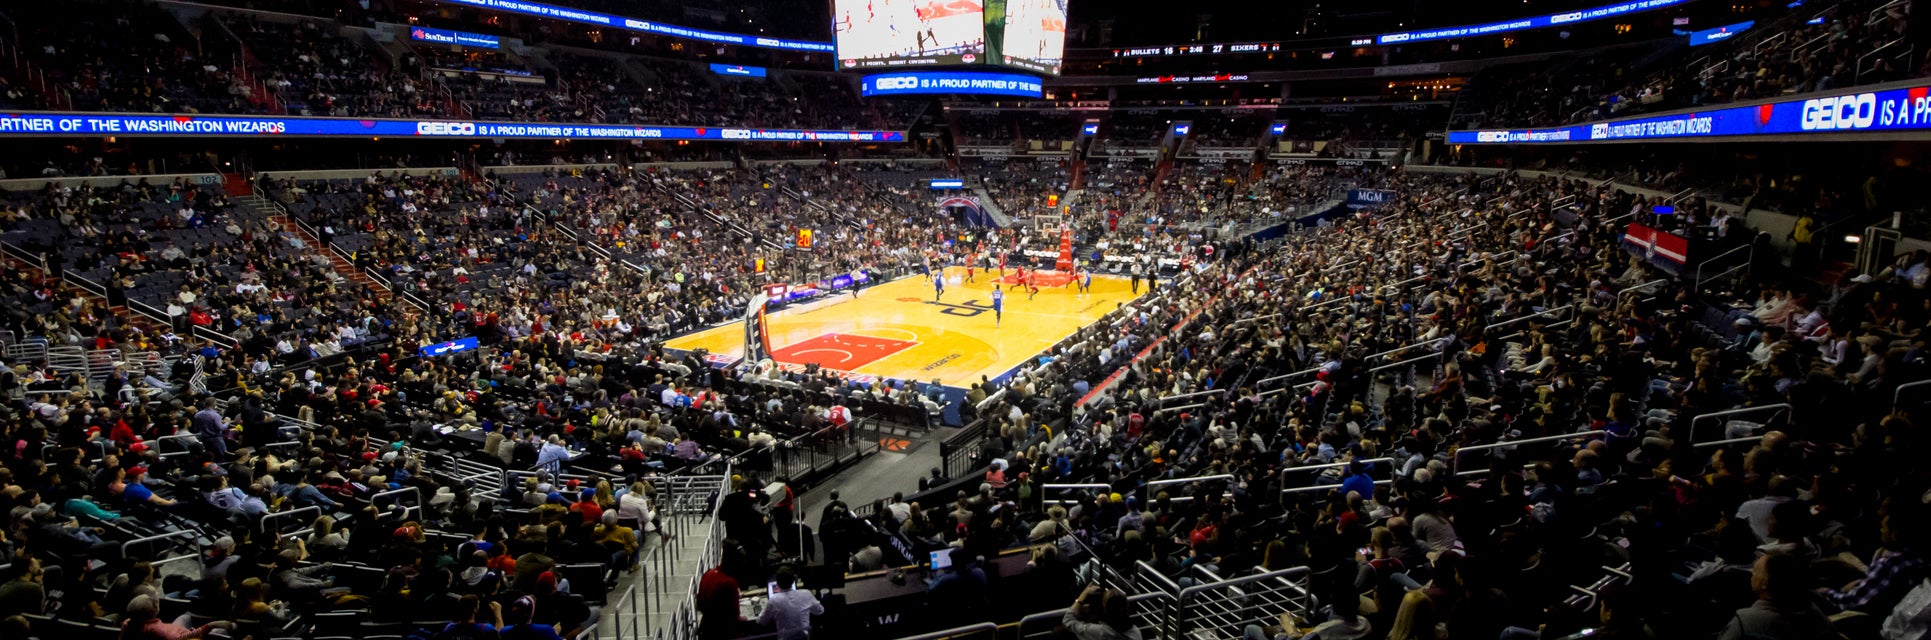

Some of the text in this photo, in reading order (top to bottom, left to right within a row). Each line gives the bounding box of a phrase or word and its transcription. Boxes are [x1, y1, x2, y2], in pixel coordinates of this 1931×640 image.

[1212, 45, 1223, 53] 27
[876, 76, 918, 90] GEICO
[921, 79, 930, 88] IS
[931, 79, 938, 88] A
[940, 79, 970, 88] PROUD
[971, 79, 1007, 89] PARTNER
[1008, 81, 1018, 90] OF
[1018, 82, 1029, 91] THE
[1802, 93, 1876, 130] GEICO
[1880, 99, 1895, 126] IS
[1897, 99, 1909, 125] A
[0, 118, 286, 133] RTNER OF THE WASHINGTON WIZARDS
[417, 122, 662, 138] GEICO IS A PROUD PARTNER OF THE WASHINGTON WIZARDS
[1655, 119, 1686, 135] WASHINGTON
[1686, 117, 1713, 134] WIZARDS
[201, 176, 217, 184] 102
[1358, 191, 1383, 202] MGM
